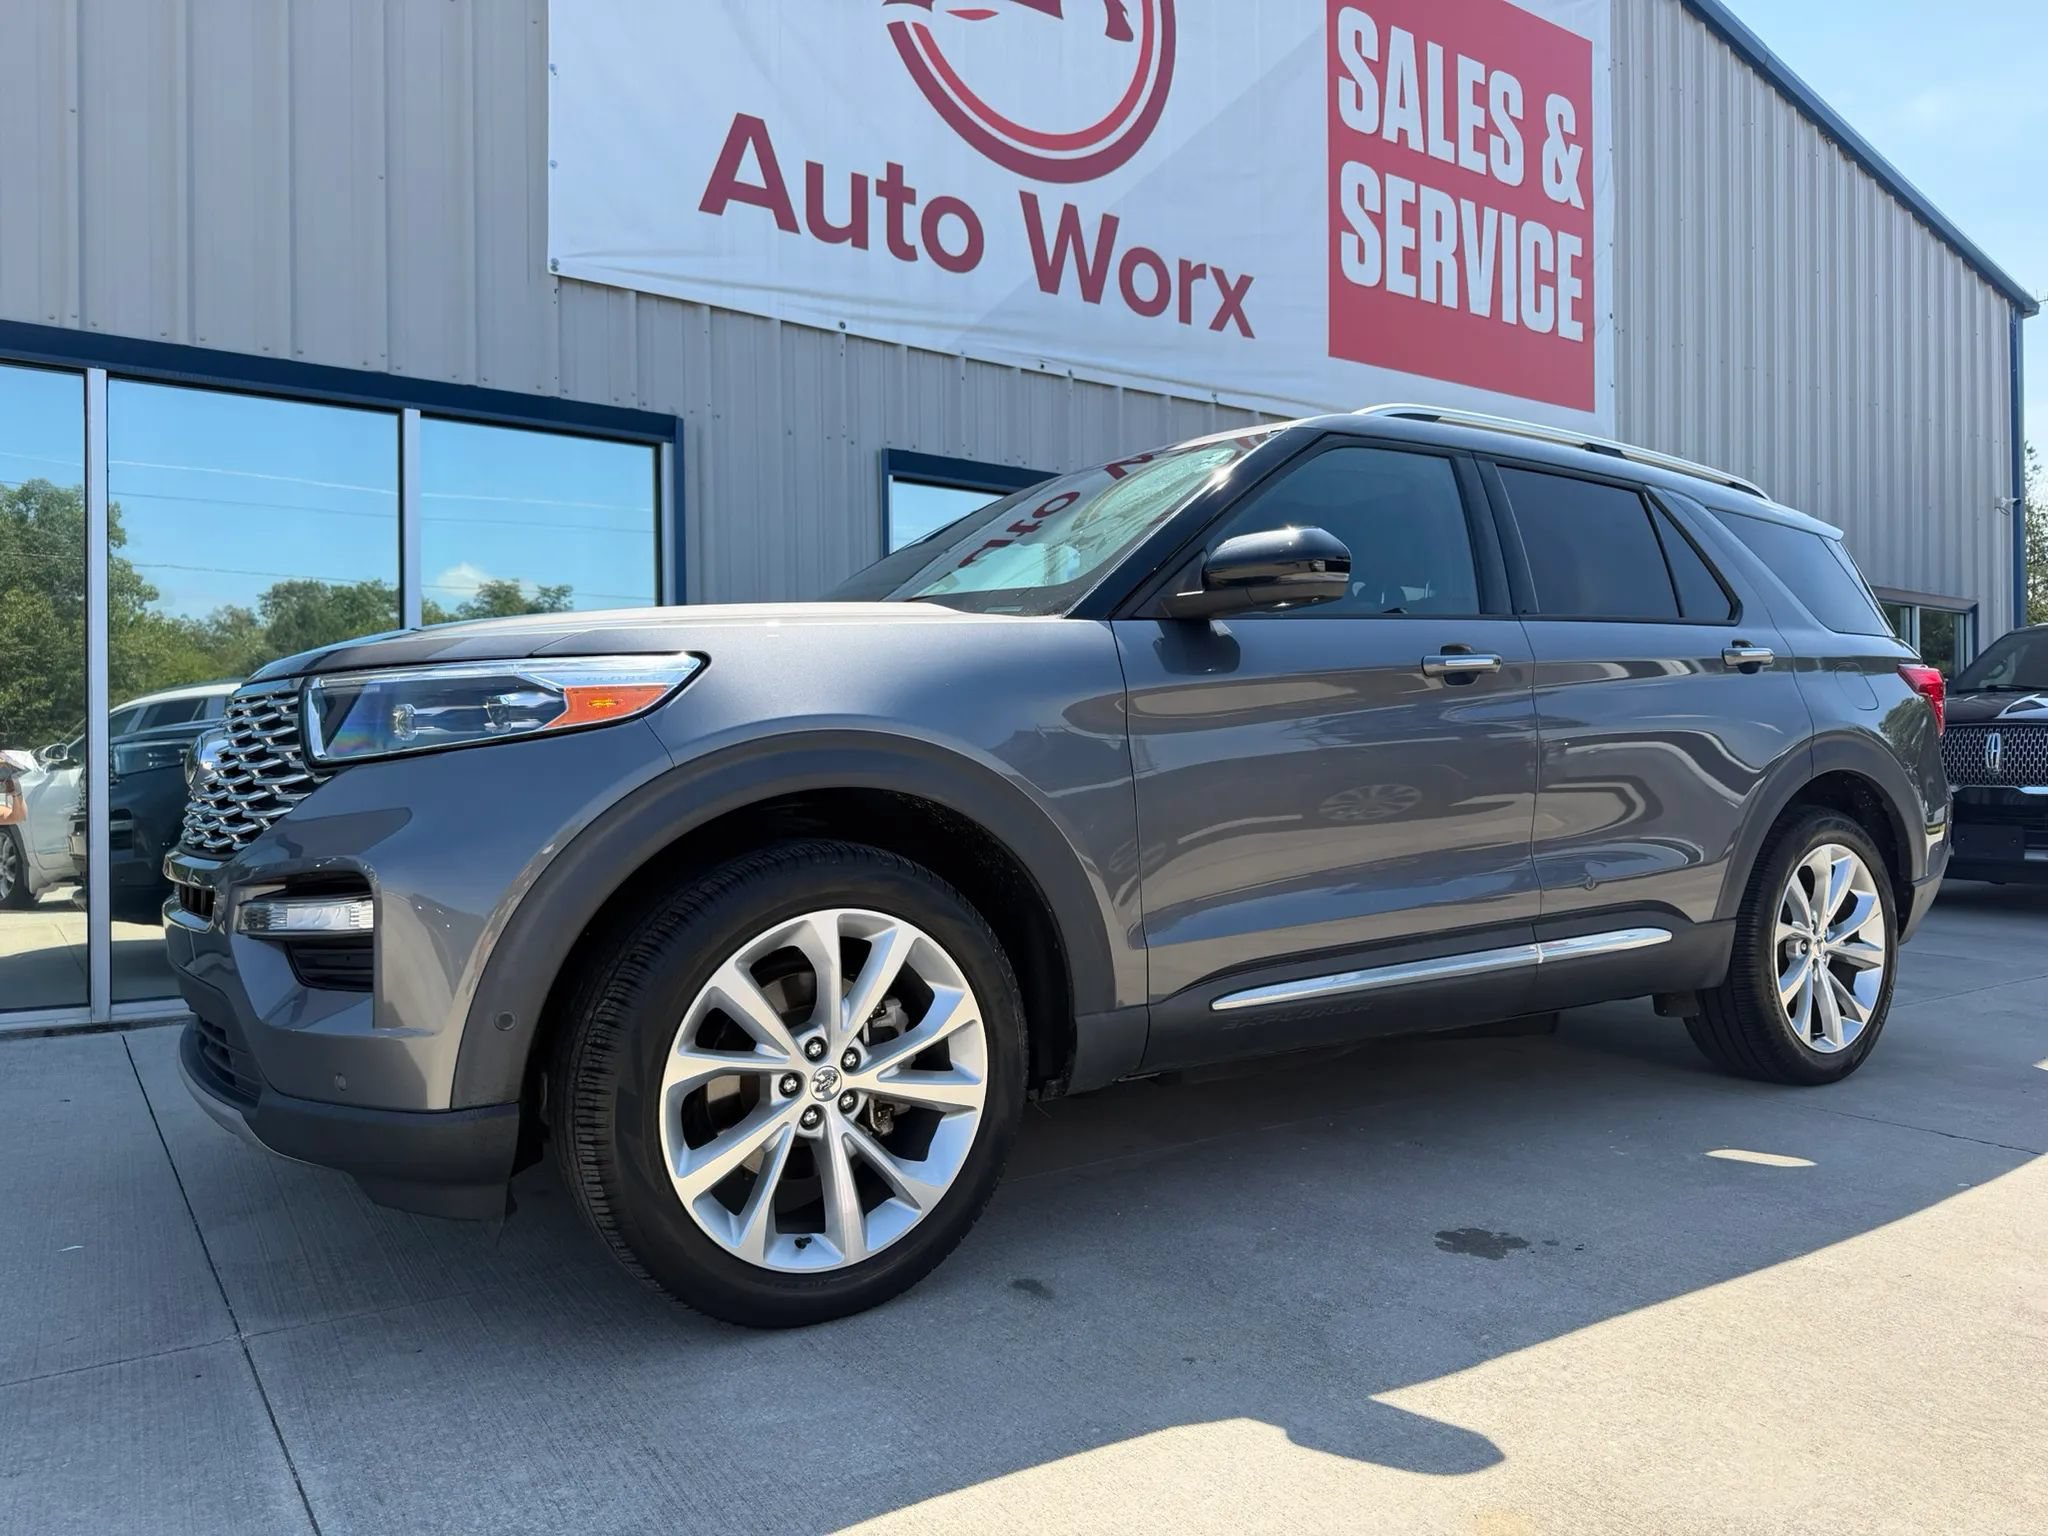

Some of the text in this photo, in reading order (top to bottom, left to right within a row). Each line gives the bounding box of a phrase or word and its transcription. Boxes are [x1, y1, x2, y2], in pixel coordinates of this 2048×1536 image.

[1337, 5, 1585, 210] SALES &
[699, 112, 1255, 338] Auto Worx
[1339, 159, 1585, 343] SERVICE
